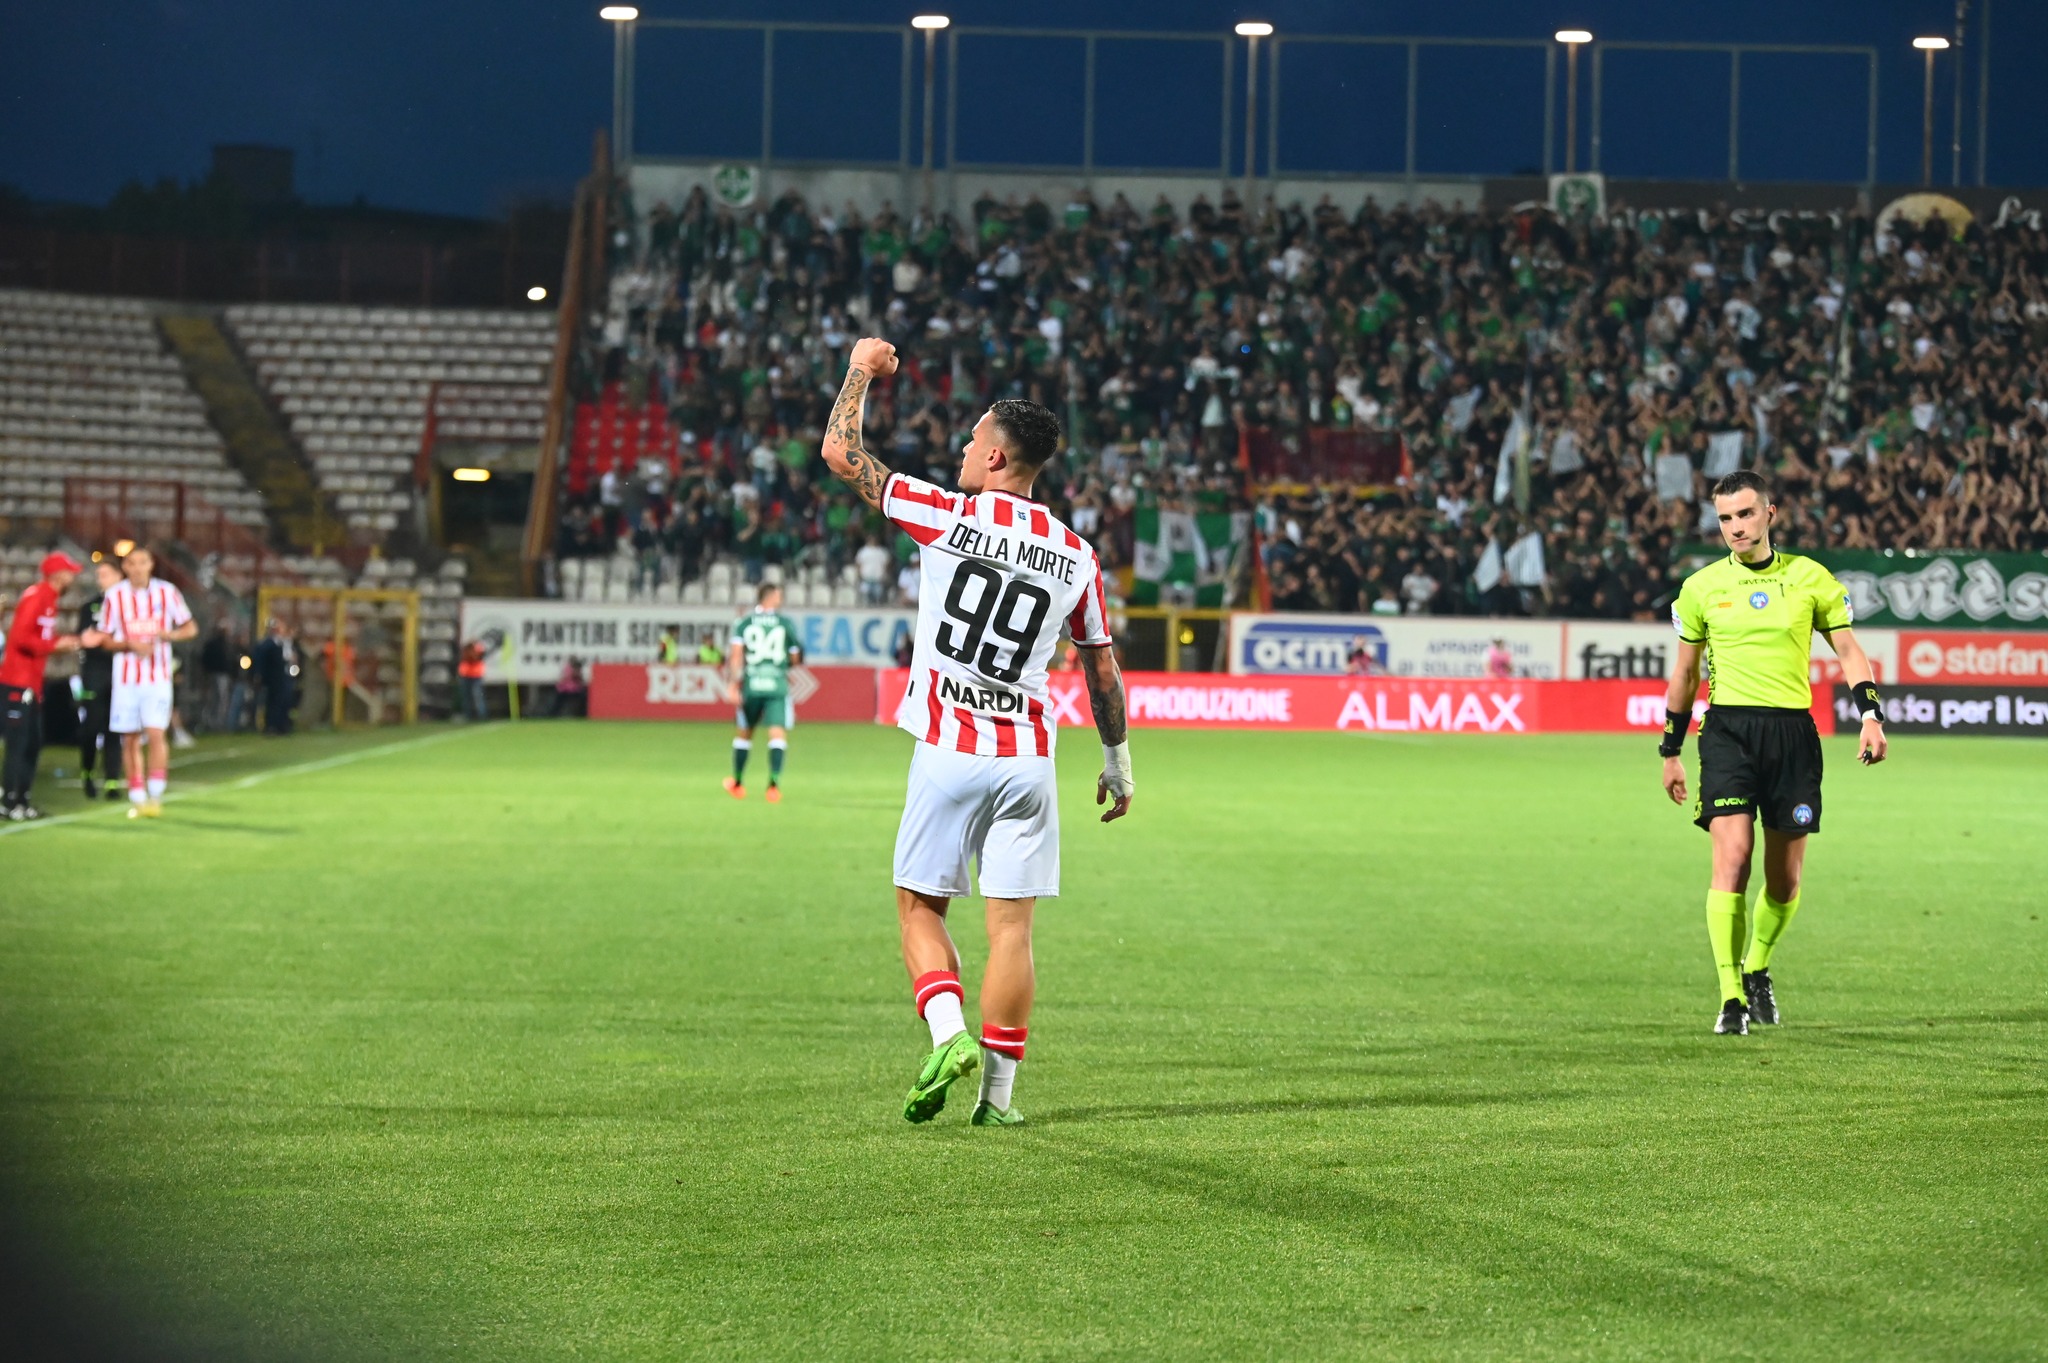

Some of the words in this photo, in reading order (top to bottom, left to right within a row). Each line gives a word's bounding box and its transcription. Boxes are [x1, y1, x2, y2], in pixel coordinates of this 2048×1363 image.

[948, 523, 1008, 561] DELLA
[1016, 541, 1076, 585] MORTE
[522, 620, 617, 645] PANTERE
[935, 560, 1051, 683] 99
[743, 624, 787, 666] 94
[941, 677, 1024, 714] NARDI
[1129, 685, 1293, 722] PRODUZIONE
[1336, 691, 1526, 732] ALMAX
[1940, 700, 1993, 728] per
[1995, 695, 2011, 725] il
